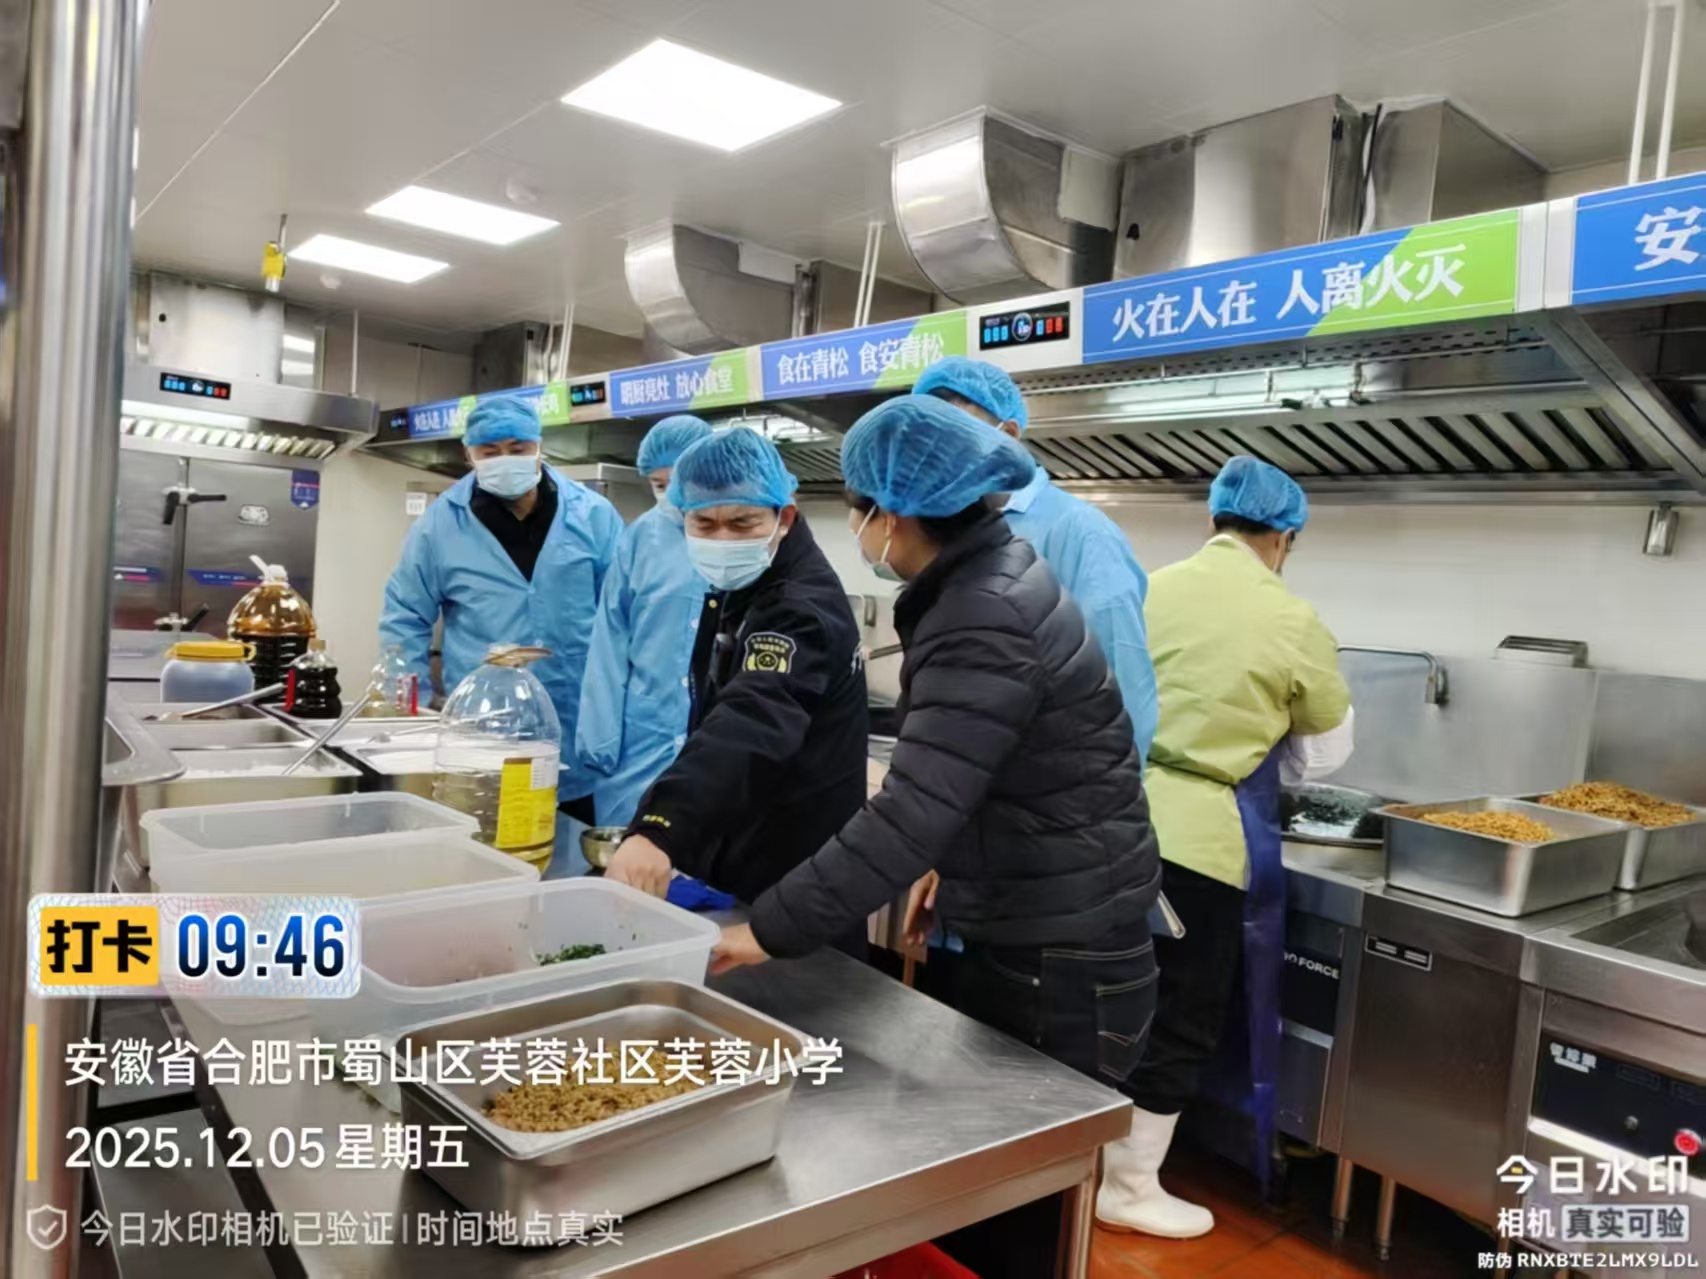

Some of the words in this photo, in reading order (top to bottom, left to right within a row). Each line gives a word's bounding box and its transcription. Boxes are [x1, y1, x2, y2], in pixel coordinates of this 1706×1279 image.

[1634, 205, 1703, 272] 安
[1111, 279, 1257, 343] 火在人在
[1276, 243, 1466, 320] 人离火灭
[619, 374, 671, 406] 明厨亮灶
[675, 364, 734, 399] 放心食堂
[777, 346, 850, 386] 食在青松
[857, 331, 945, 377] 食安青松
[1298, 956, 1340, 980] FORCE
